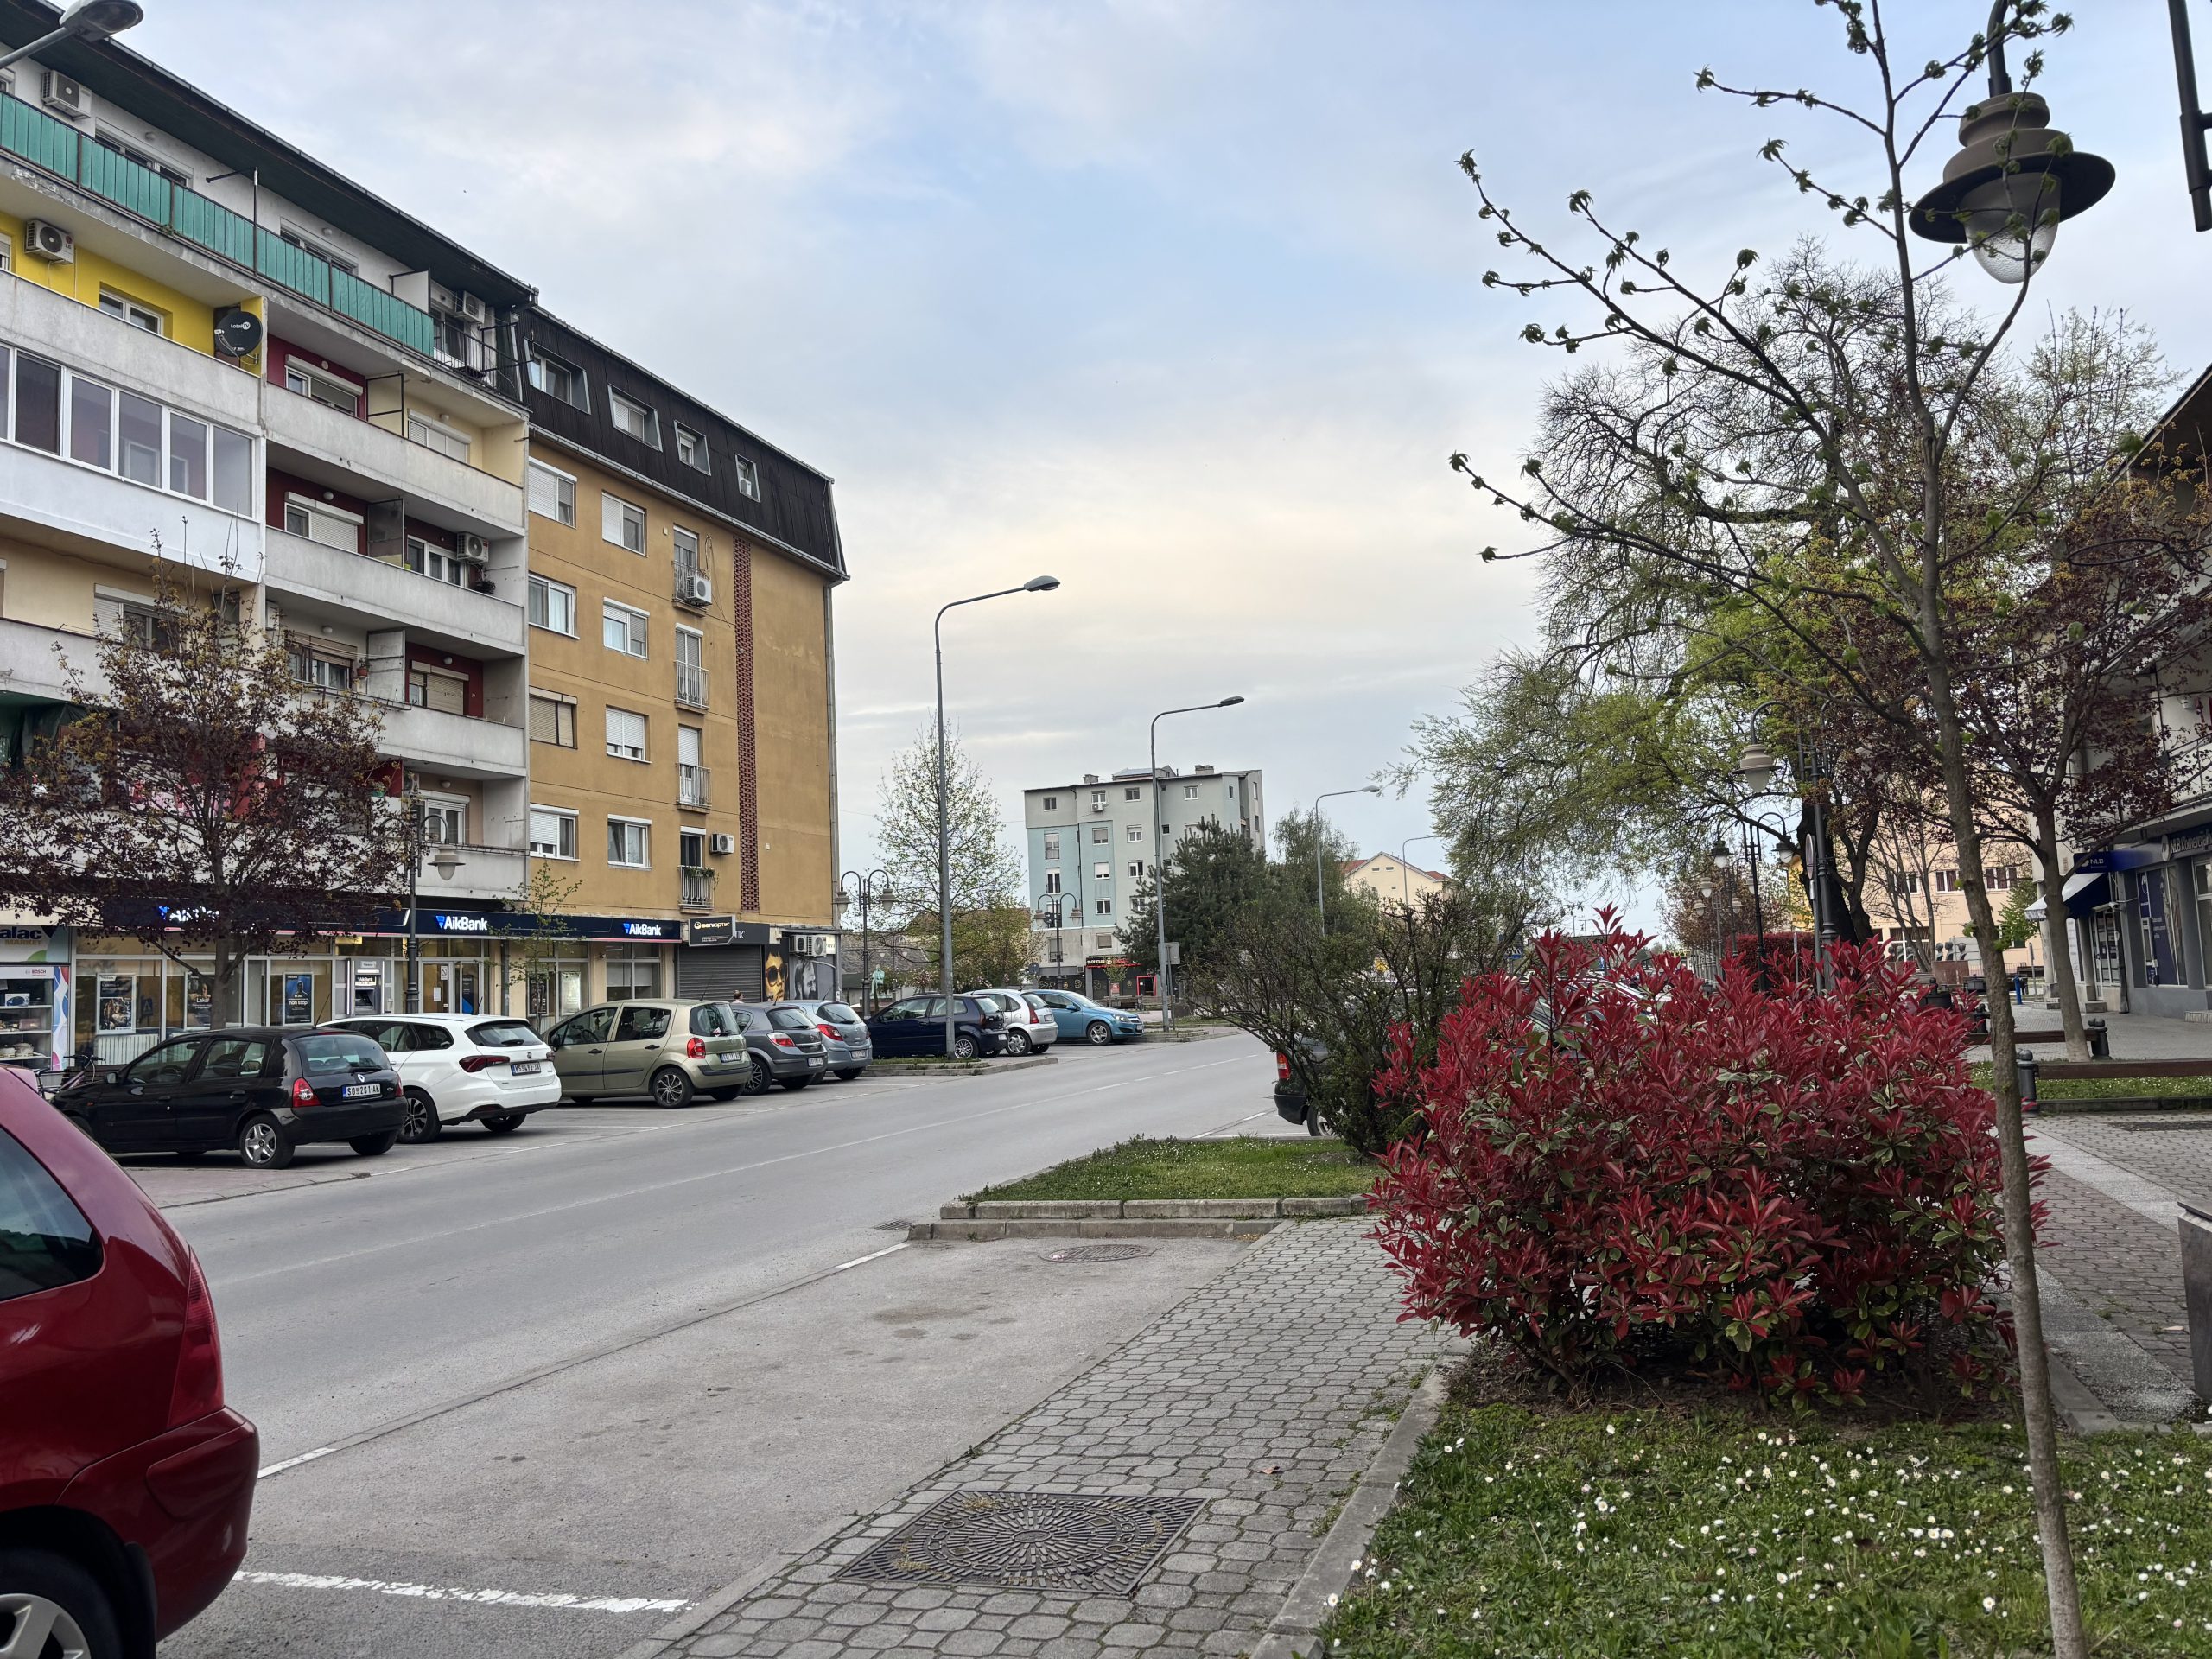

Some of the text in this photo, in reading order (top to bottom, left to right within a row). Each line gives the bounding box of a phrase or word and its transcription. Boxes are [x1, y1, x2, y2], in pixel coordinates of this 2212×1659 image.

[2170, 837, 2181, 854] NLB
[443, 916, 488, 931] AikBank
[629, 923, 662, 936] AikBank
